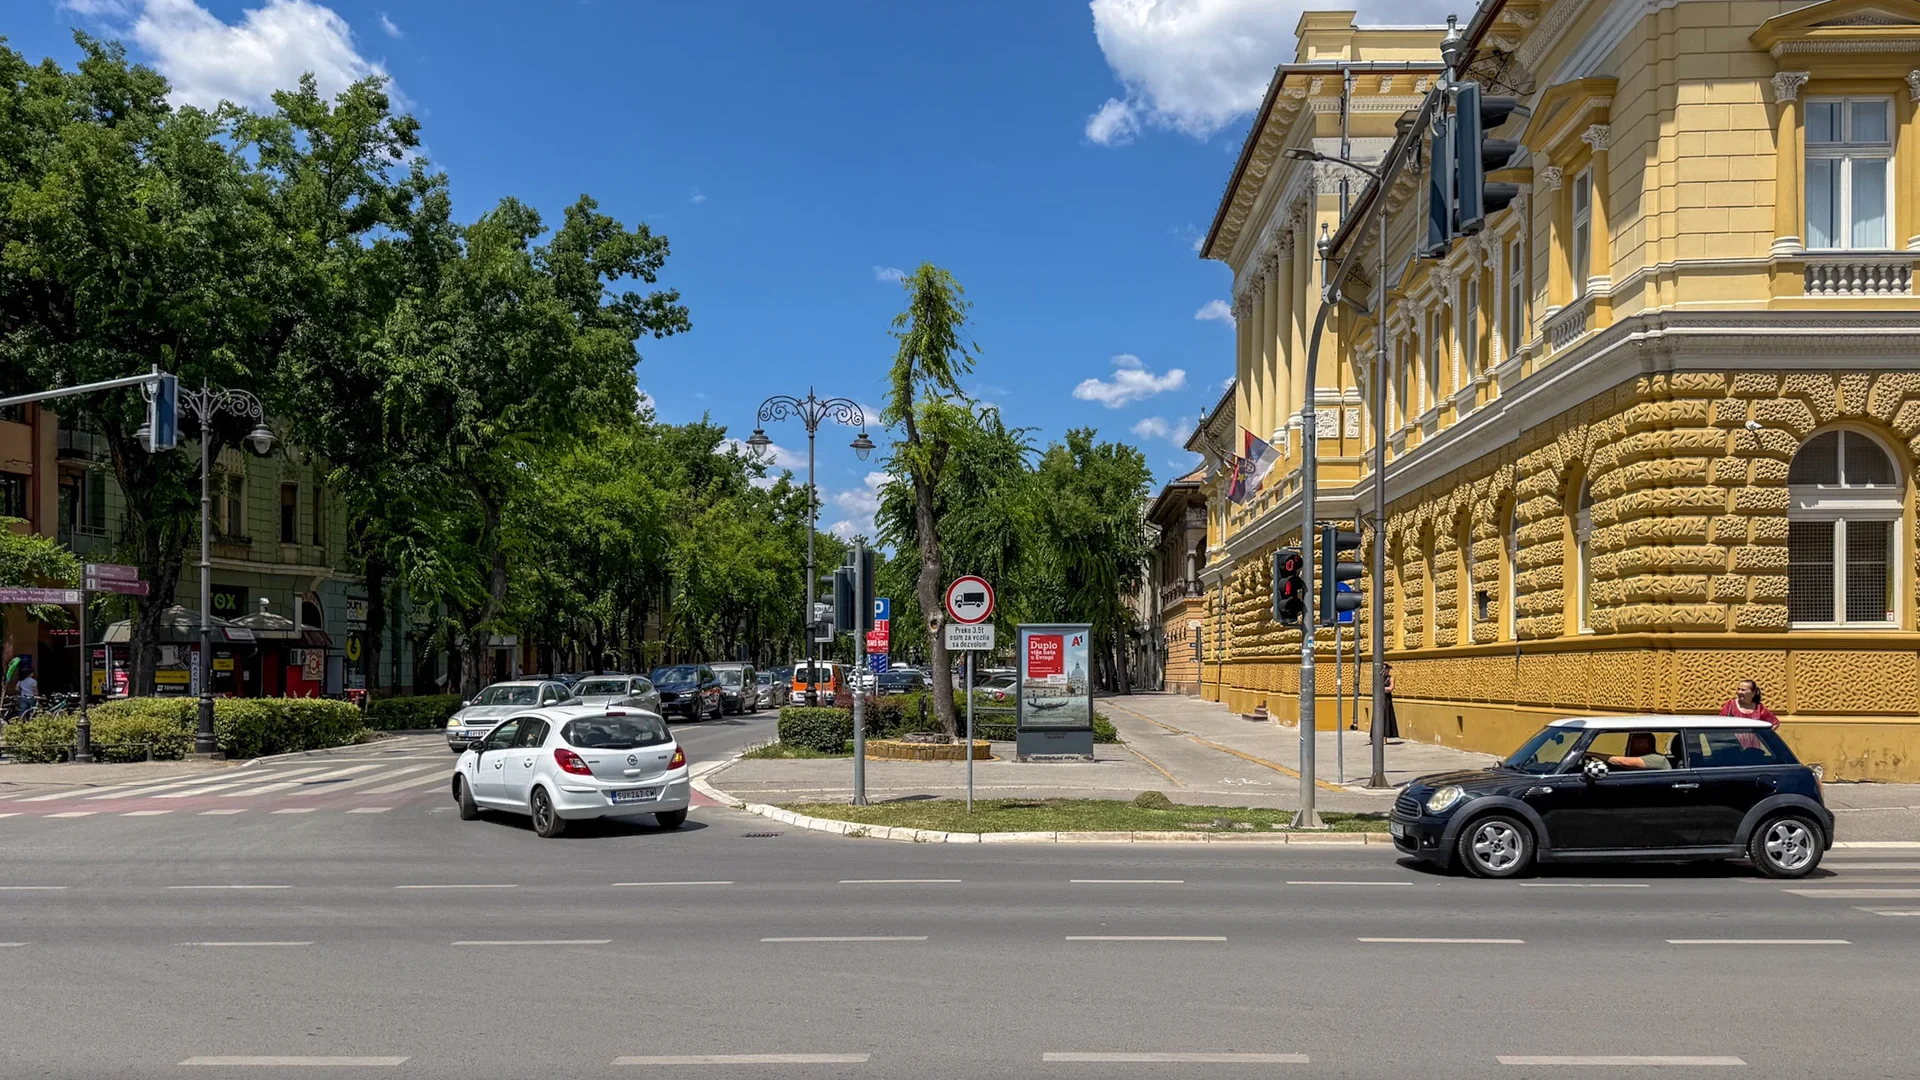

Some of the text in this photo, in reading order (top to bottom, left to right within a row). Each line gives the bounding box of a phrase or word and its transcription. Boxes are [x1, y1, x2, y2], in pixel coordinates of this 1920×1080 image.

[210, 592, 236, 609] OX
[874, 600, 884, 618] P
[1030, 641, 1058, 651] Duplo
[1071, 635, 1083, 647] A1
